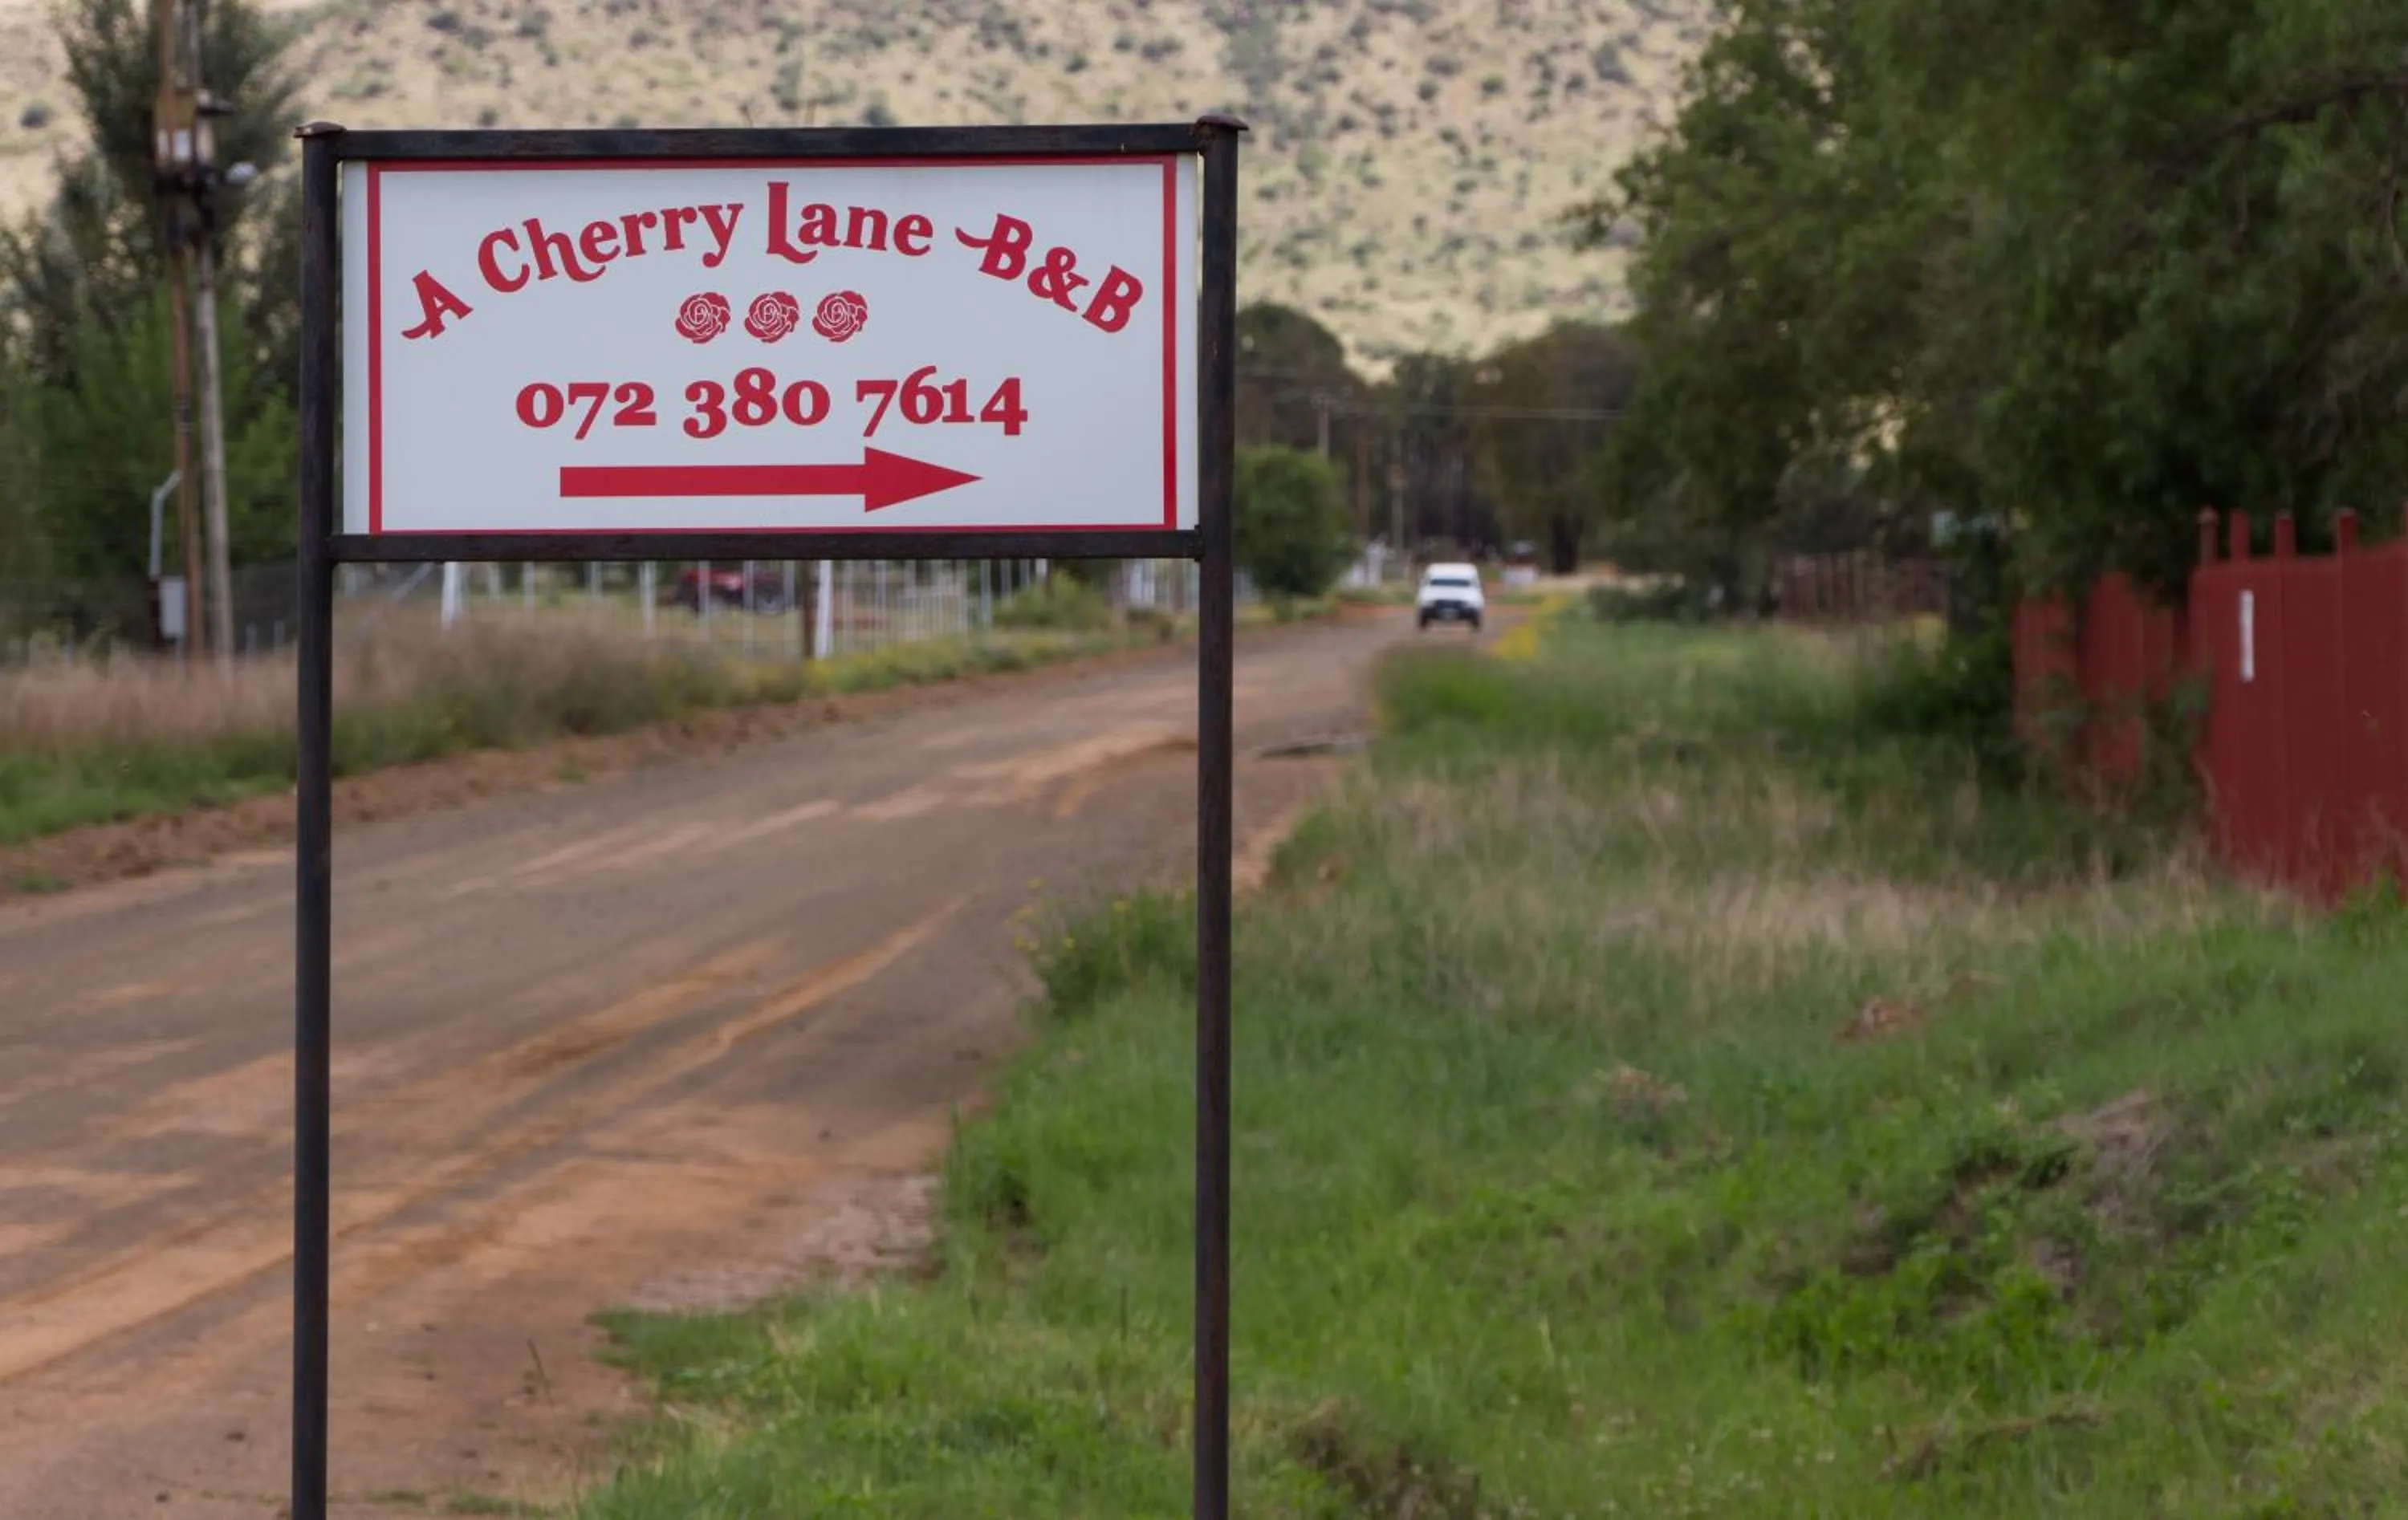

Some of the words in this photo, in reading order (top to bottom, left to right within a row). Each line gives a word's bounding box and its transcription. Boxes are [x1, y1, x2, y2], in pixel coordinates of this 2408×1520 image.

[401, 270, 473, 339] A
[478, 202, 743, 293] Cherry
[767, 181, 934, 264] Lane
[955, 213, 1143, 333] B&B
[515, 381, 657, 439] 072
[683, 367, 830, 437] 380
[856, 365, 1028, 437] 7614
